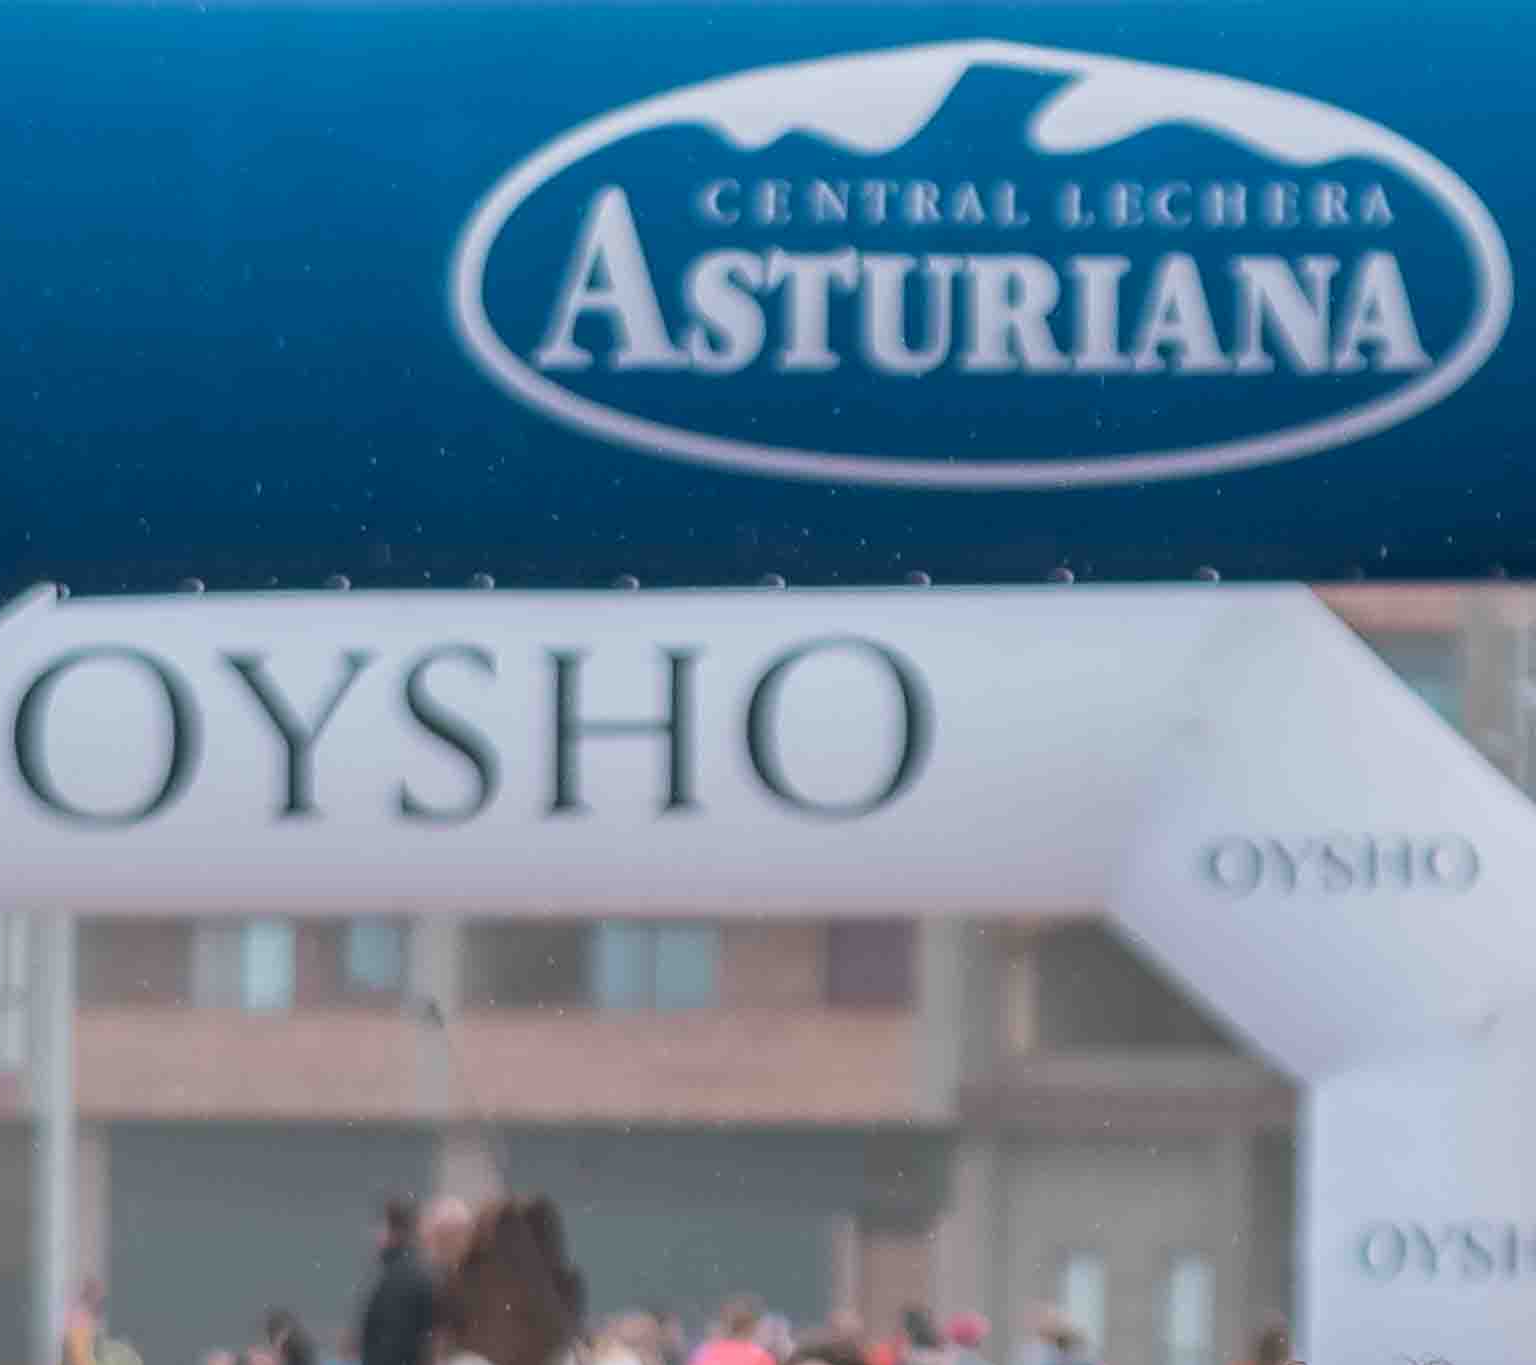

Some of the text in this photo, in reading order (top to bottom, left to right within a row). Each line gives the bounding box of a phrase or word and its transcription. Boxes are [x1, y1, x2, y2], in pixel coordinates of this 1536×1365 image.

[697, 179, 1396, 229] CENTRAL LECHERA
[535, 186, 1434, 376] ASTURIANA
[10, 632, 939, 832] OYSHO
[1197, 832, 1483, 899] OYSHO
